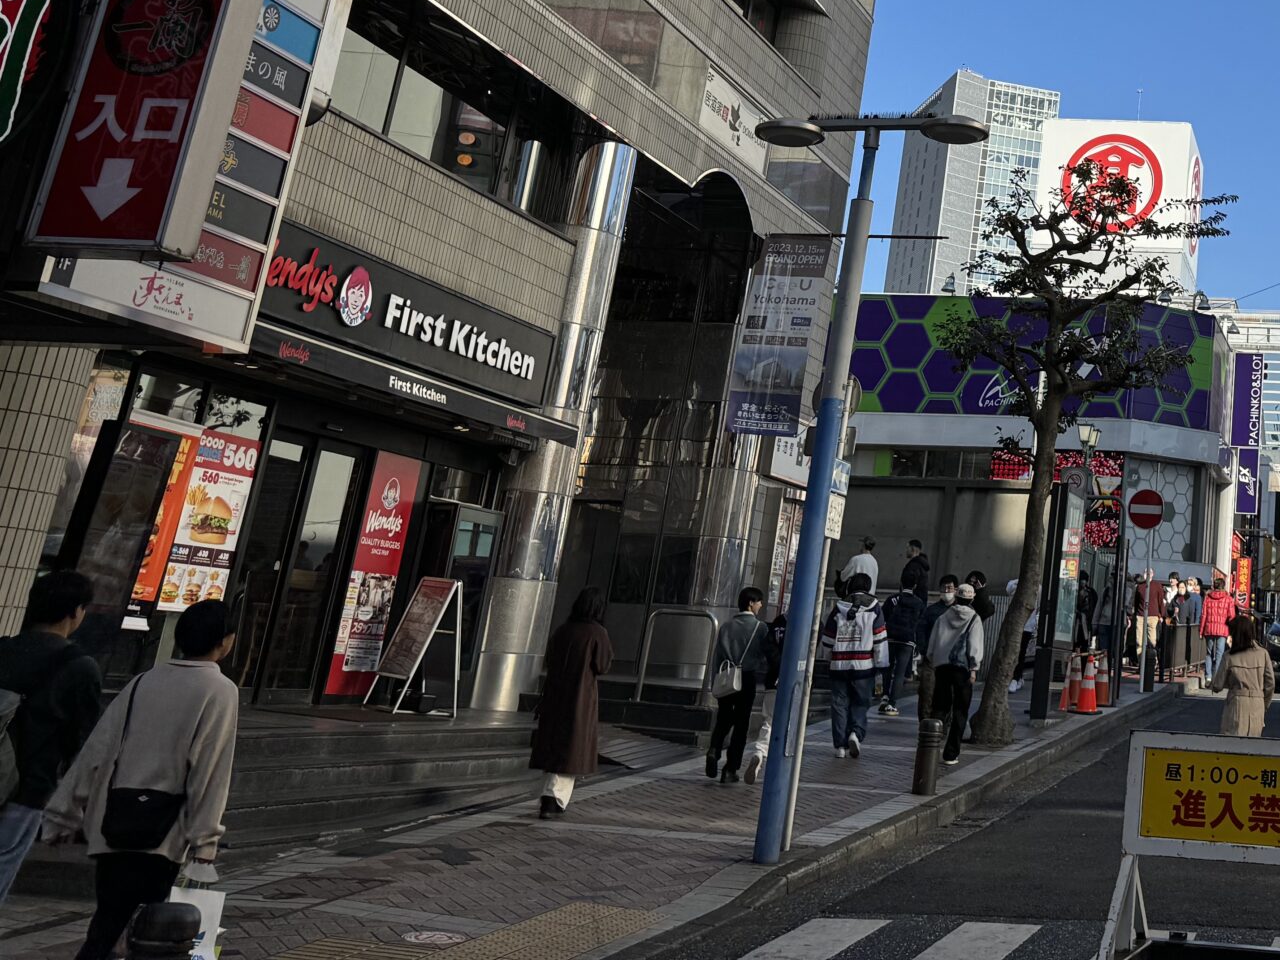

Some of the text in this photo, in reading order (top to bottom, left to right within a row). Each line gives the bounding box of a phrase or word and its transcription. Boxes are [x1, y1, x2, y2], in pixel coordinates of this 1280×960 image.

[75, 93, 192, 144] 入口
[765, 253, 825, 265] GRAND OPEN!
[265, 239, 536, 381] endy's First Kitchen
[753, 294, 816, 307] Yokohama
[278, 340, 311, 365] Wendy's
[388, 375, 447, 405] First Kitchen
[1248, 354, 1262, 446] PACHINKO&SLOT
[199, 434, 225, 450] GOOD
[1238, 465, 1251, 485] EX
[365, 509, 403, 538] Wendy's
[360, 536, 401, 551] QUALITY BURGERS
